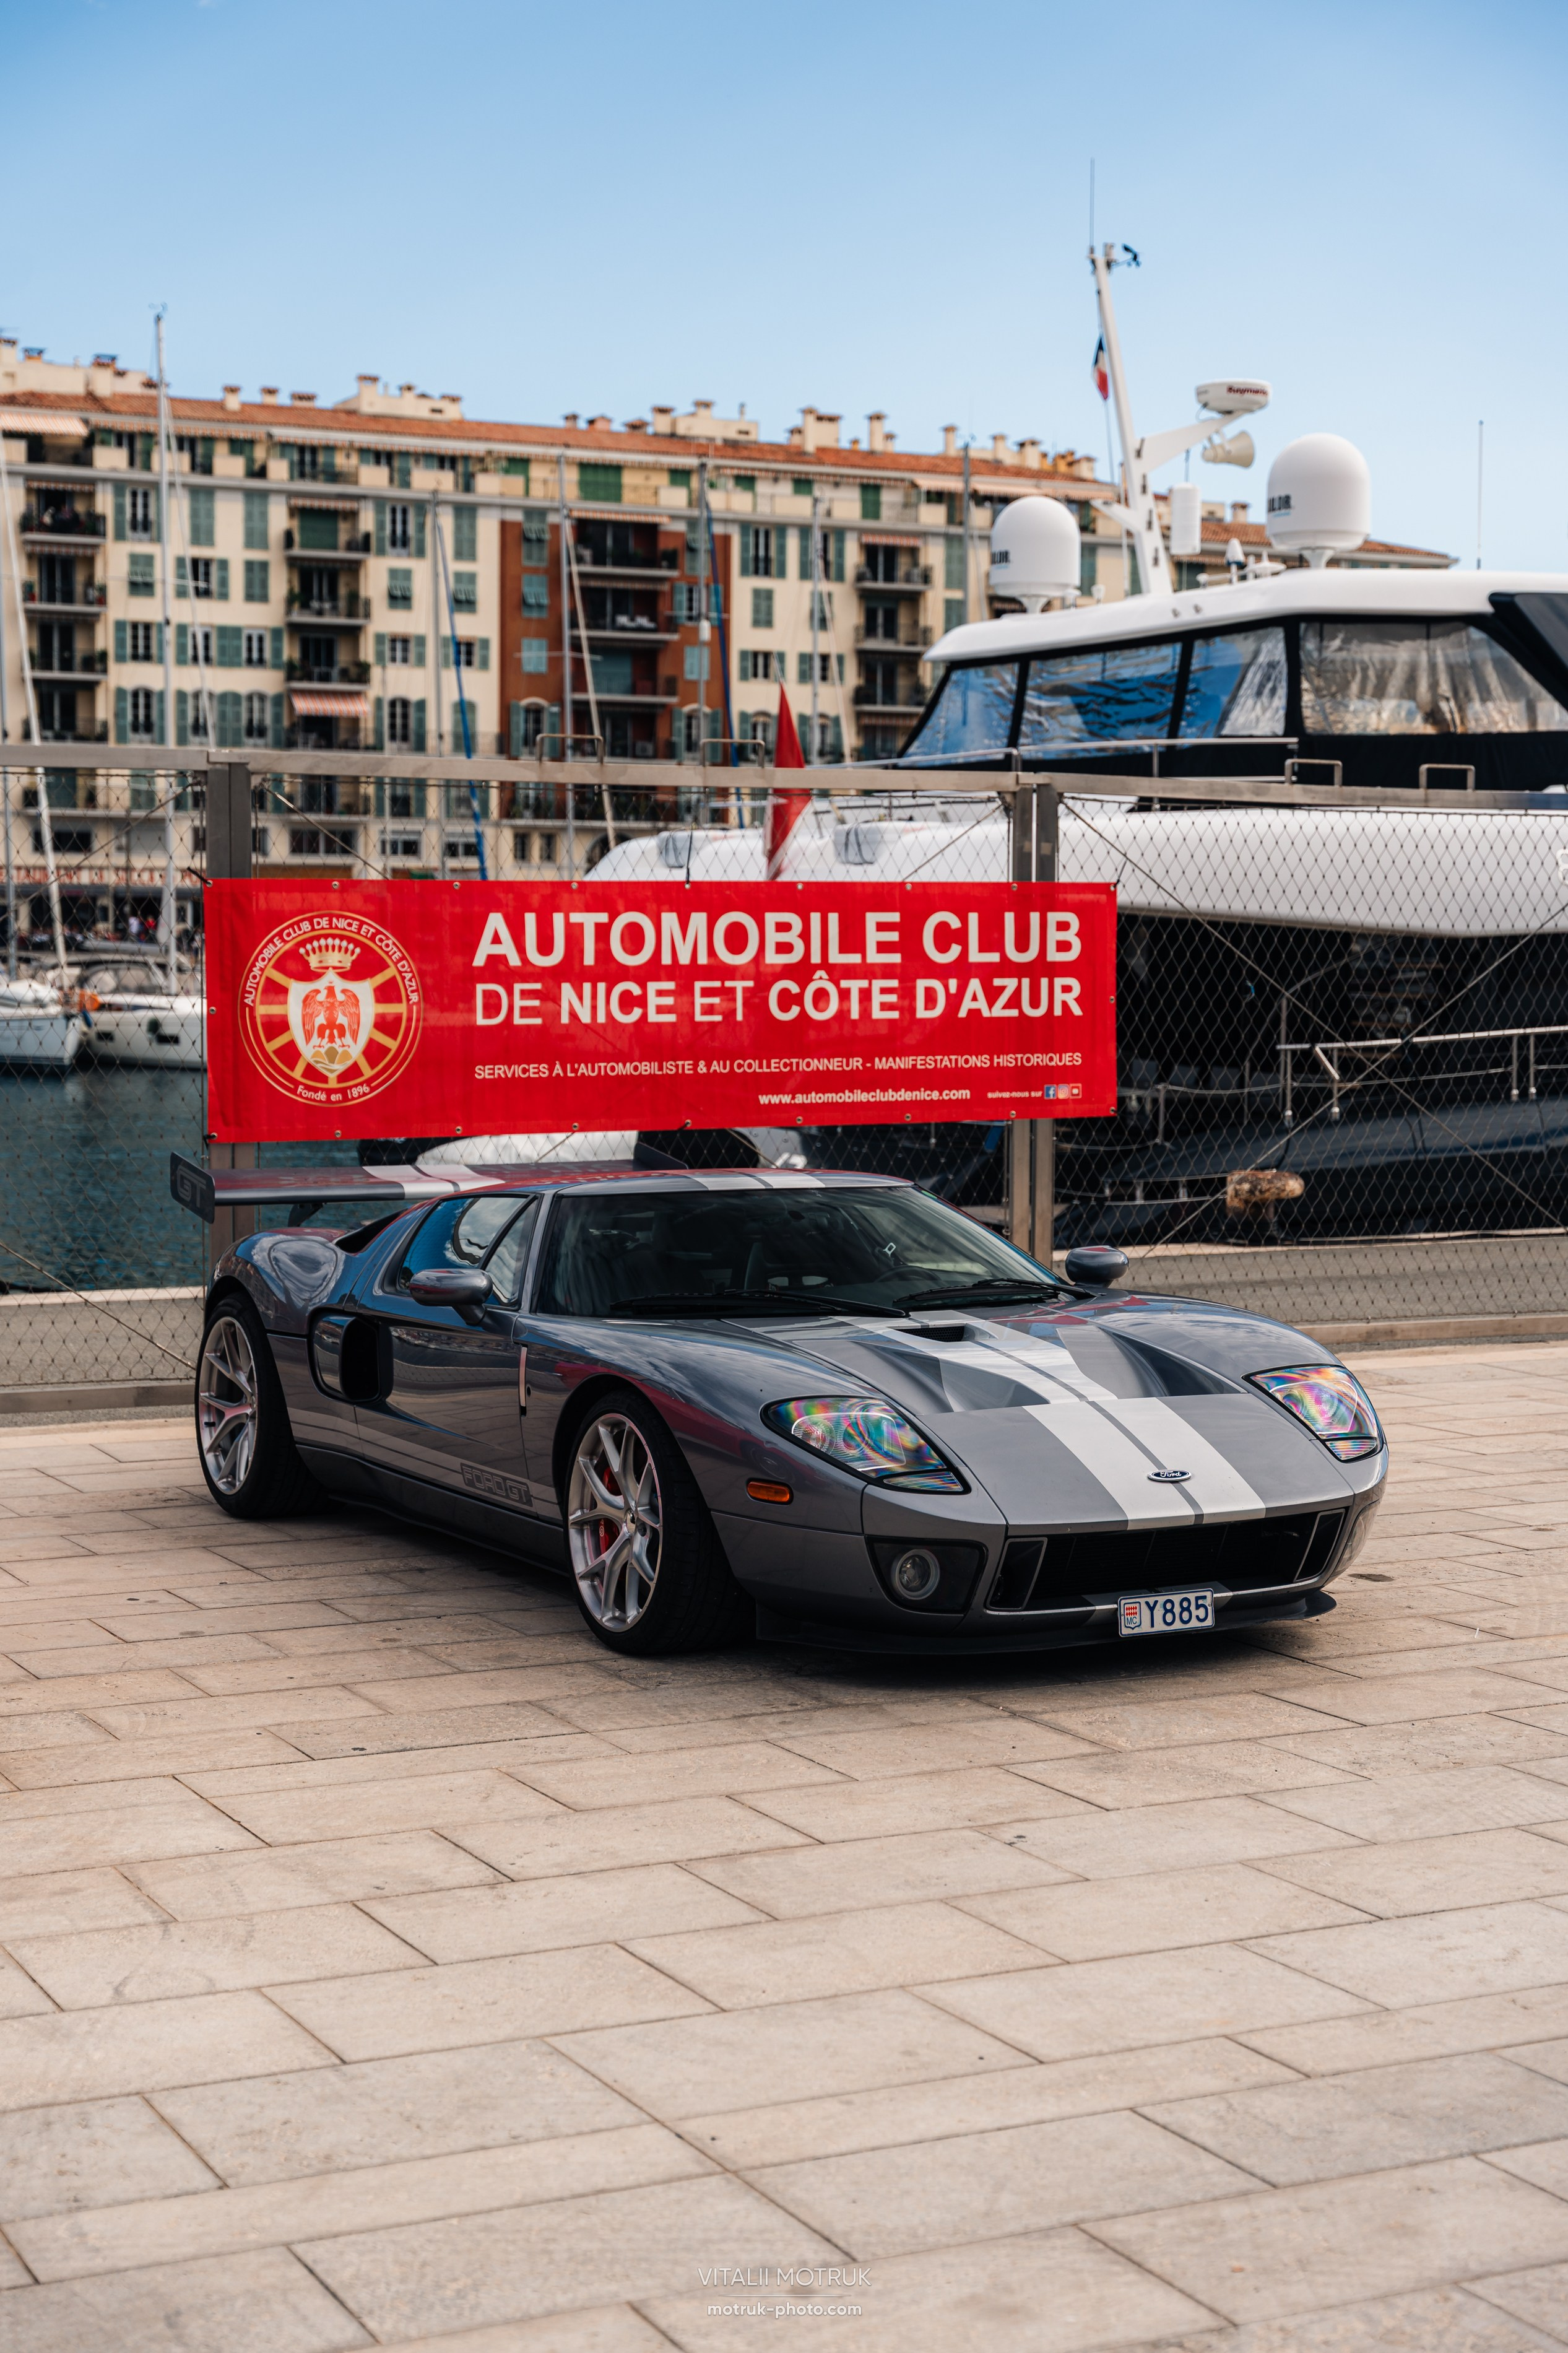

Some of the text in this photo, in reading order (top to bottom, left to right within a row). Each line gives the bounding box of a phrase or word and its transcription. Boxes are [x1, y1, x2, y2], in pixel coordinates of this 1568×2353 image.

[472, 911, 1081, 966] AUTOMOBILE CLUB
[244, 916, 419, 1007] AUTOMOBILE CLUB DE NICE ET CÔTE D'AZUR
[475, 970, 1083, 1026] DE NICE ET CÔTE D'AZUR
[474, 1063, 549, 1079] SERVICES
[552, 1061, 564, 1077] À
[567, 1059, 693, 1077] L'AUTOMOBILISTE
[697, 1060, 707, 1074] &
[709, 1059, 730, 1074] AU
[734, 1057, 863, 1073] COLLECTIONNEUR
[874, 1054, 990, 1070] MANIFESTATIONS
[994, 1052, 1082, 1068] HISTORIQUES
[297, 1084, 370, 1101] Fondé en 1896
[758, 1087, 971, 1105] www.automobileclubdenice.com
[987, 1090, 1029, 1098] suivez-nous
[177, 1165, 206, 1208] GT
[462, 1466, 527, 1503] FORD GT
[1127, 1595, 1208, 1628] MC Y885
